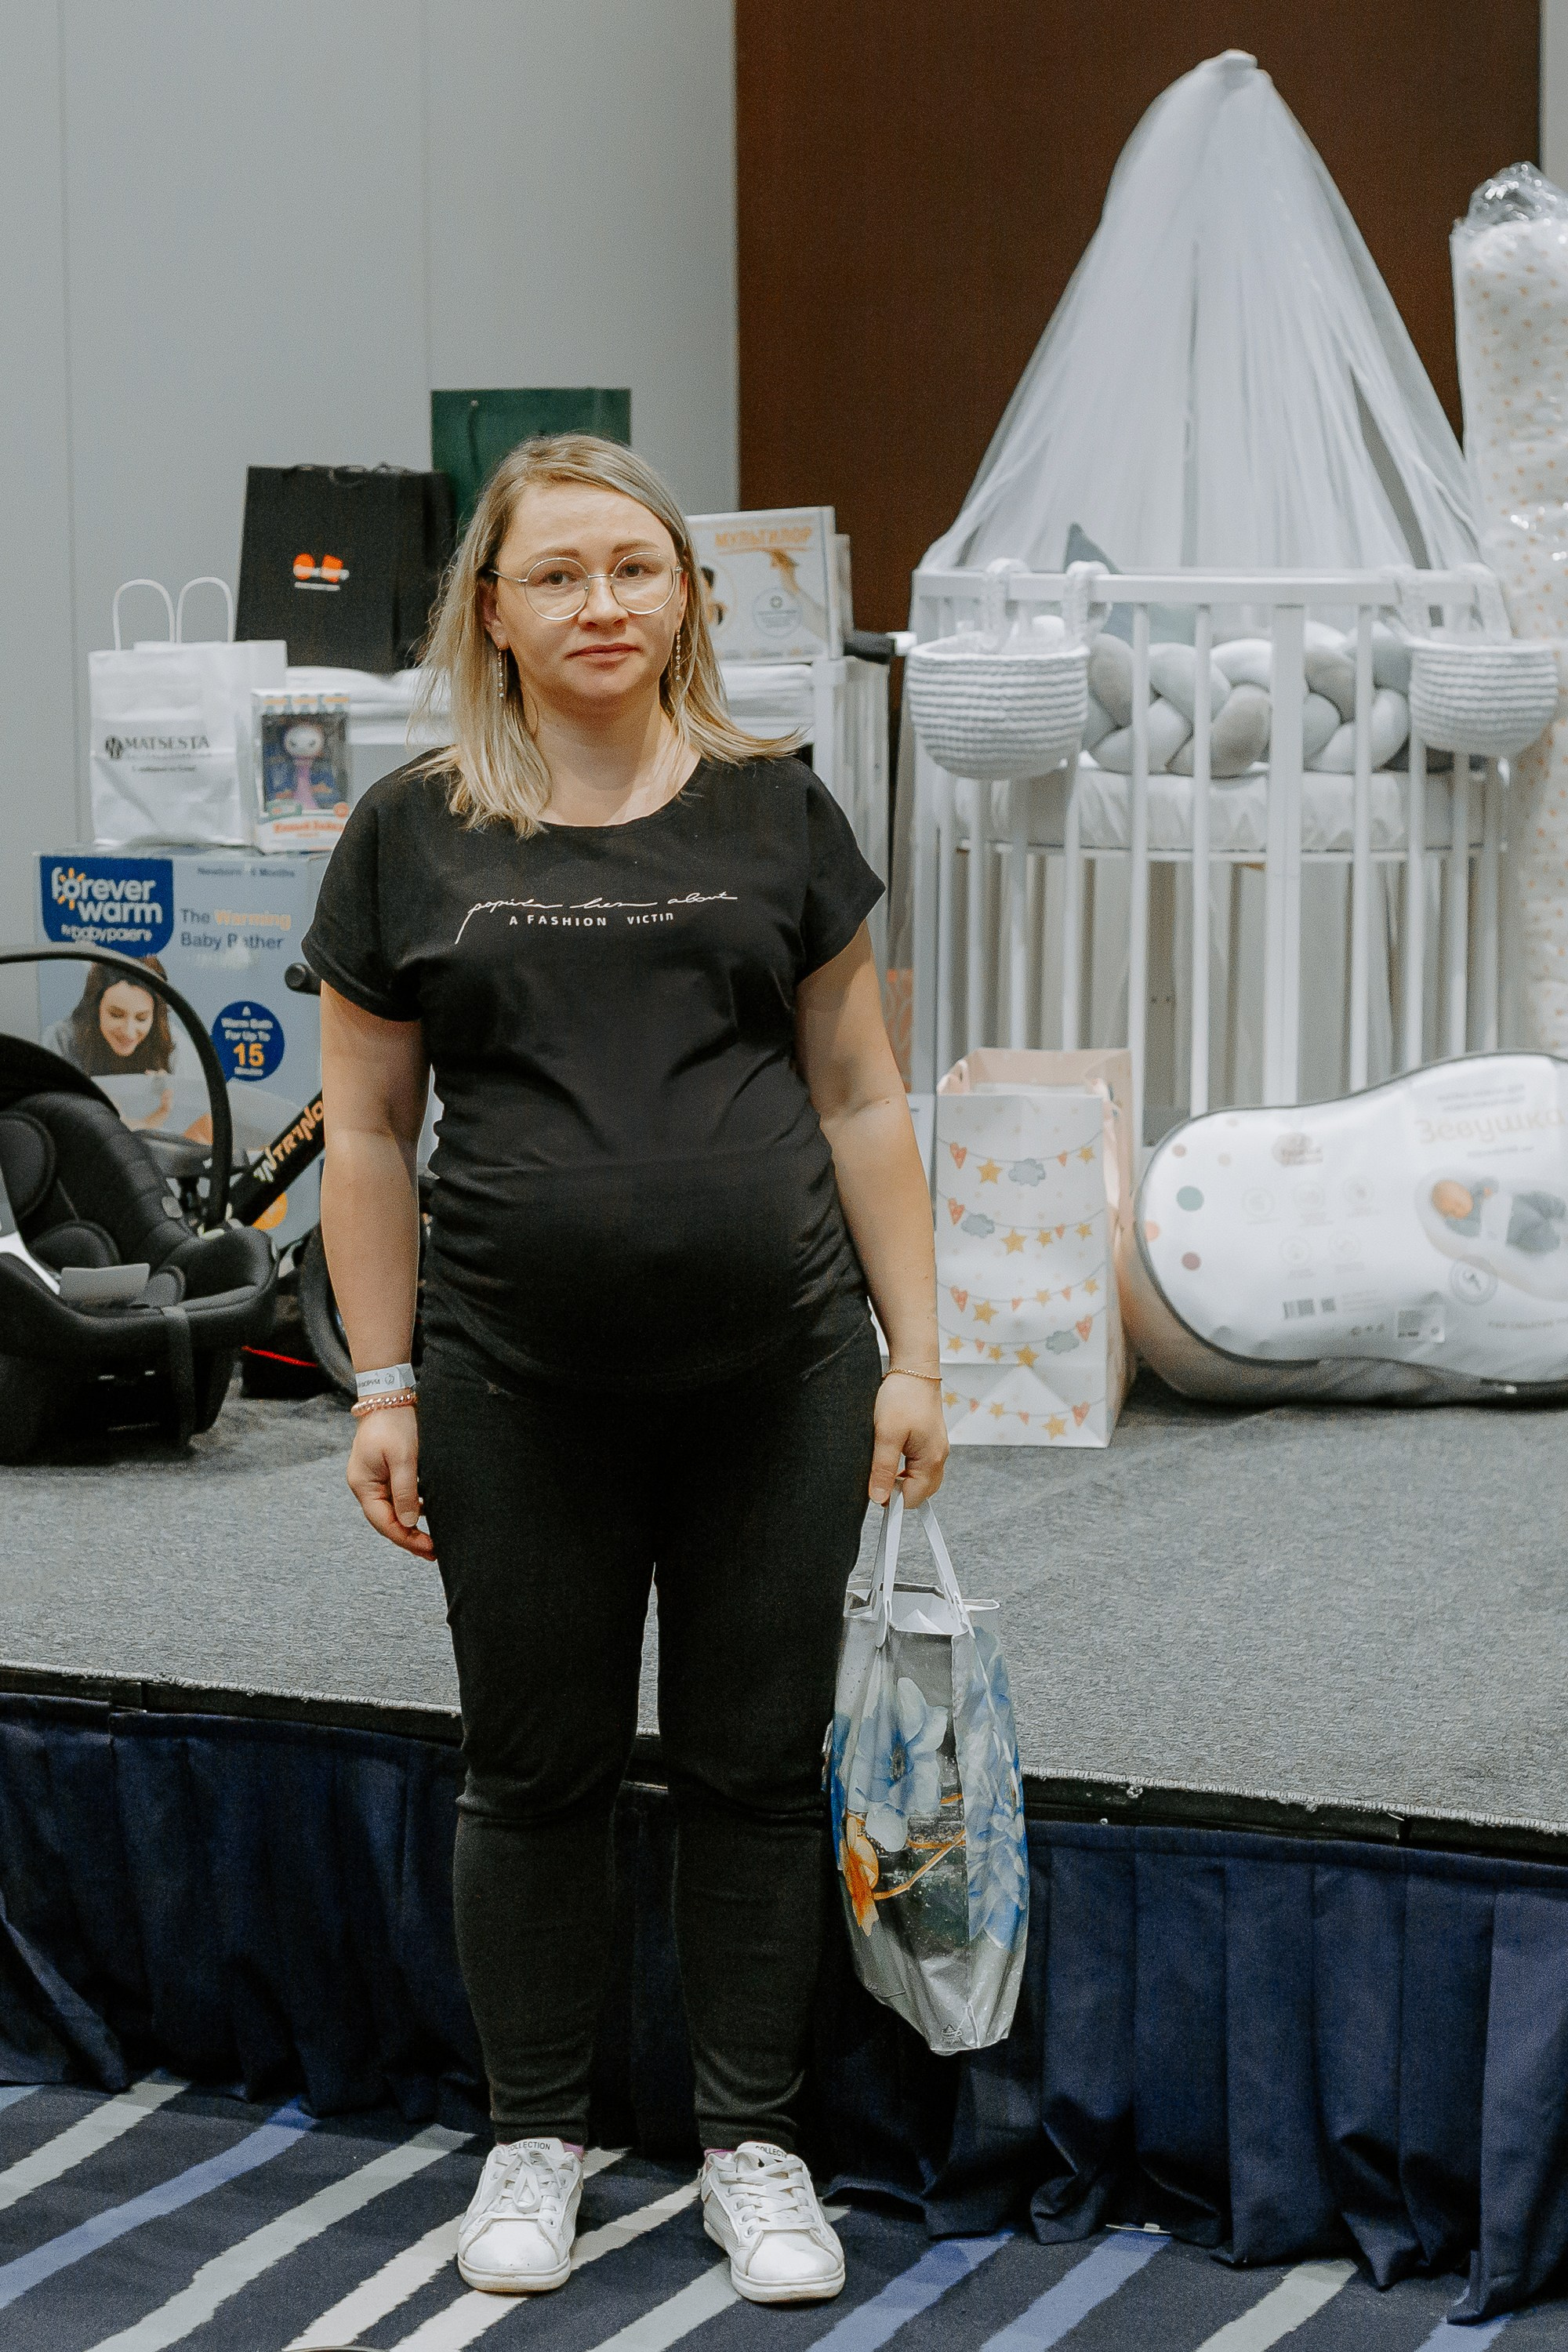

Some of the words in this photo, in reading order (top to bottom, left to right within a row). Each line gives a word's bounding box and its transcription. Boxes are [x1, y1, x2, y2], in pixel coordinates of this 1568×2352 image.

[125, 736, 209, 750] MATSESTA
[51, 867, 157, 901] forever
[78, 901, 163, 924] warm
[180, 908, 211, 924] The
[214, 909, 291, 931] Warming
[510, 916, 517, 925] A
[527, 914, 607, 927] FASHION
[180, 931, 222, 951] Baby
[233, 1043, 264, 1066] 15
